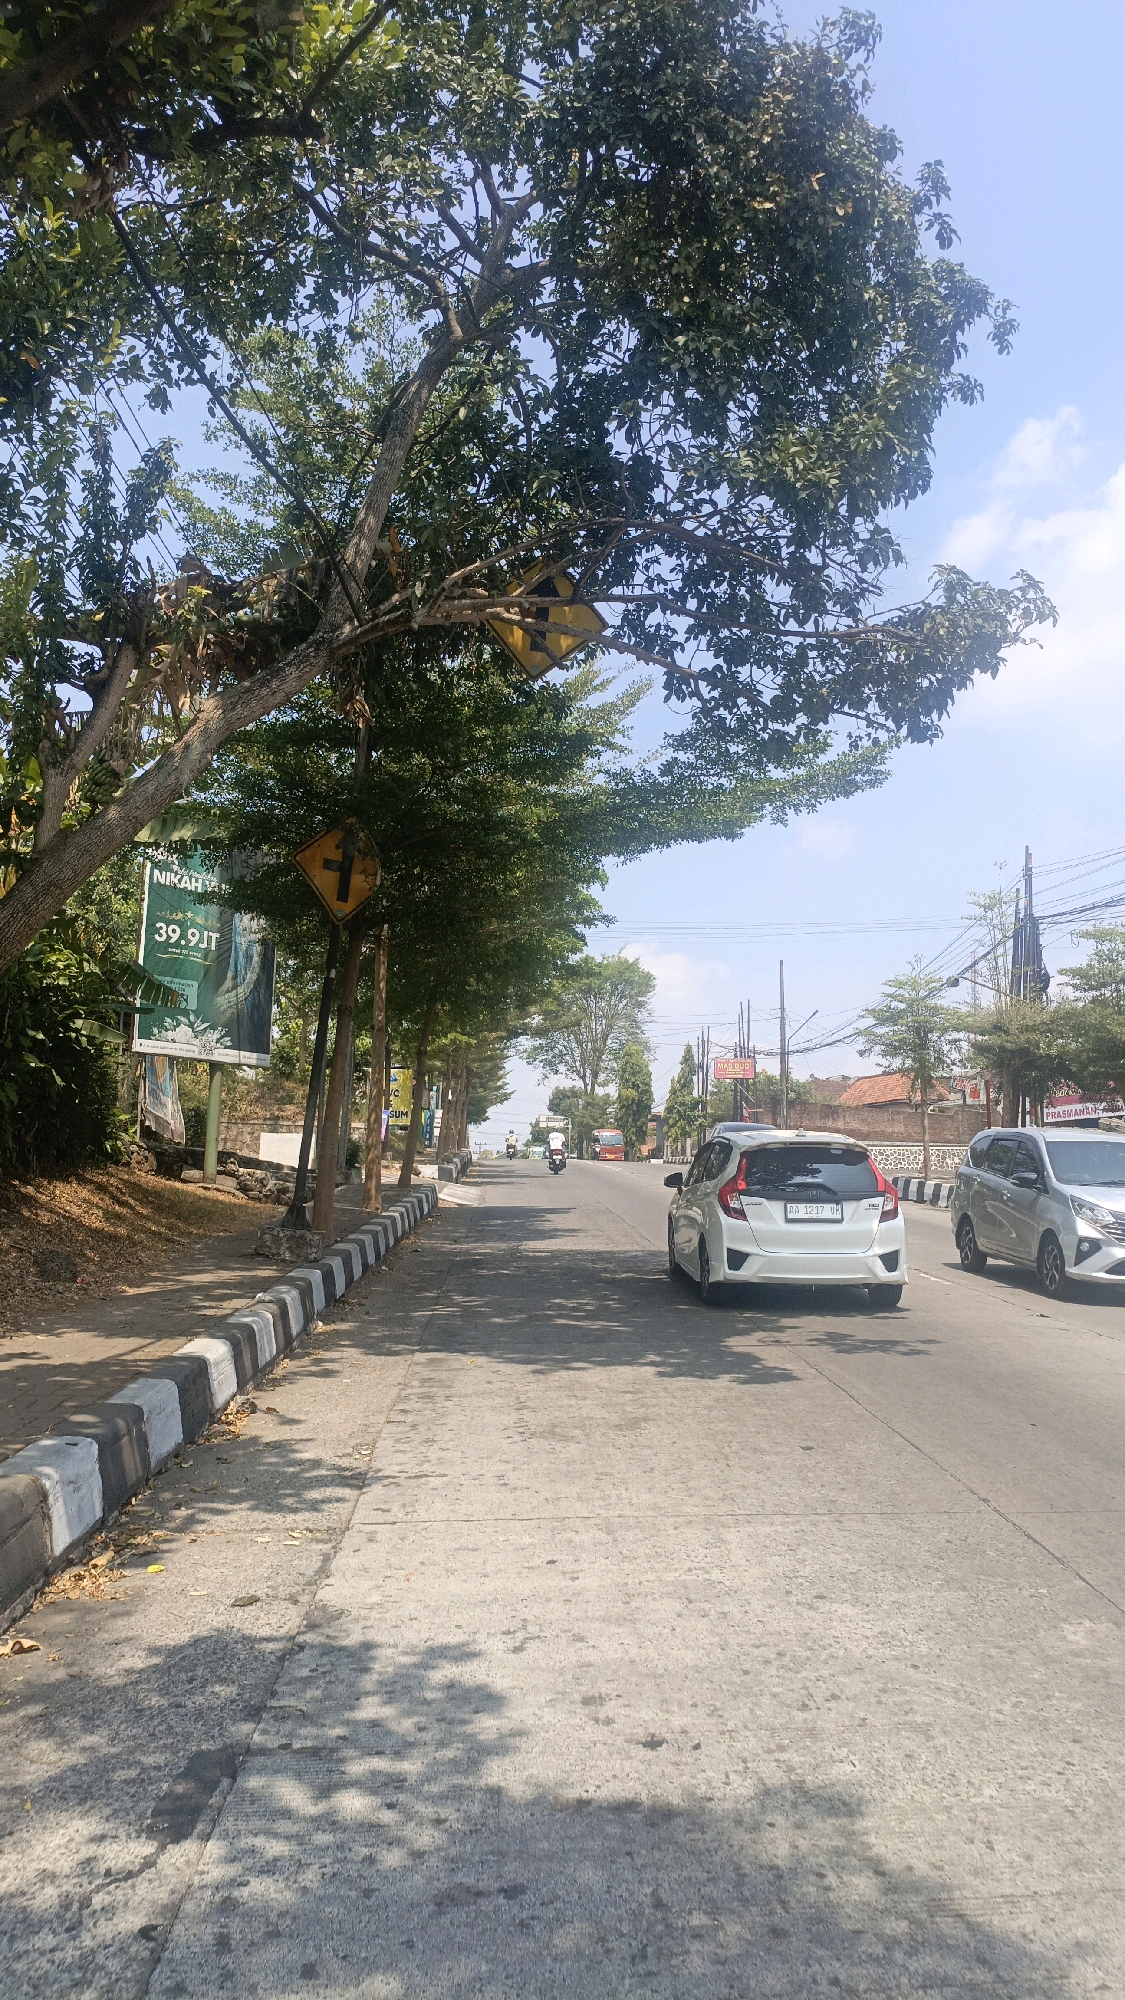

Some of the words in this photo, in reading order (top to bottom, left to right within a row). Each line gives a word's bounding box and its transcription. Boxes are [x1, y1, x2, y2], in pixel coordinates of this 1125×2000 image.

[153, 869, 203, 893] NIKAH
[154, 922, 220, 951] 39.9JT
[734, 1062, 752, 1070] BUDI
[789, 1205, 800, 1215] AA
[804, 1205, 825, 1215] 1217
